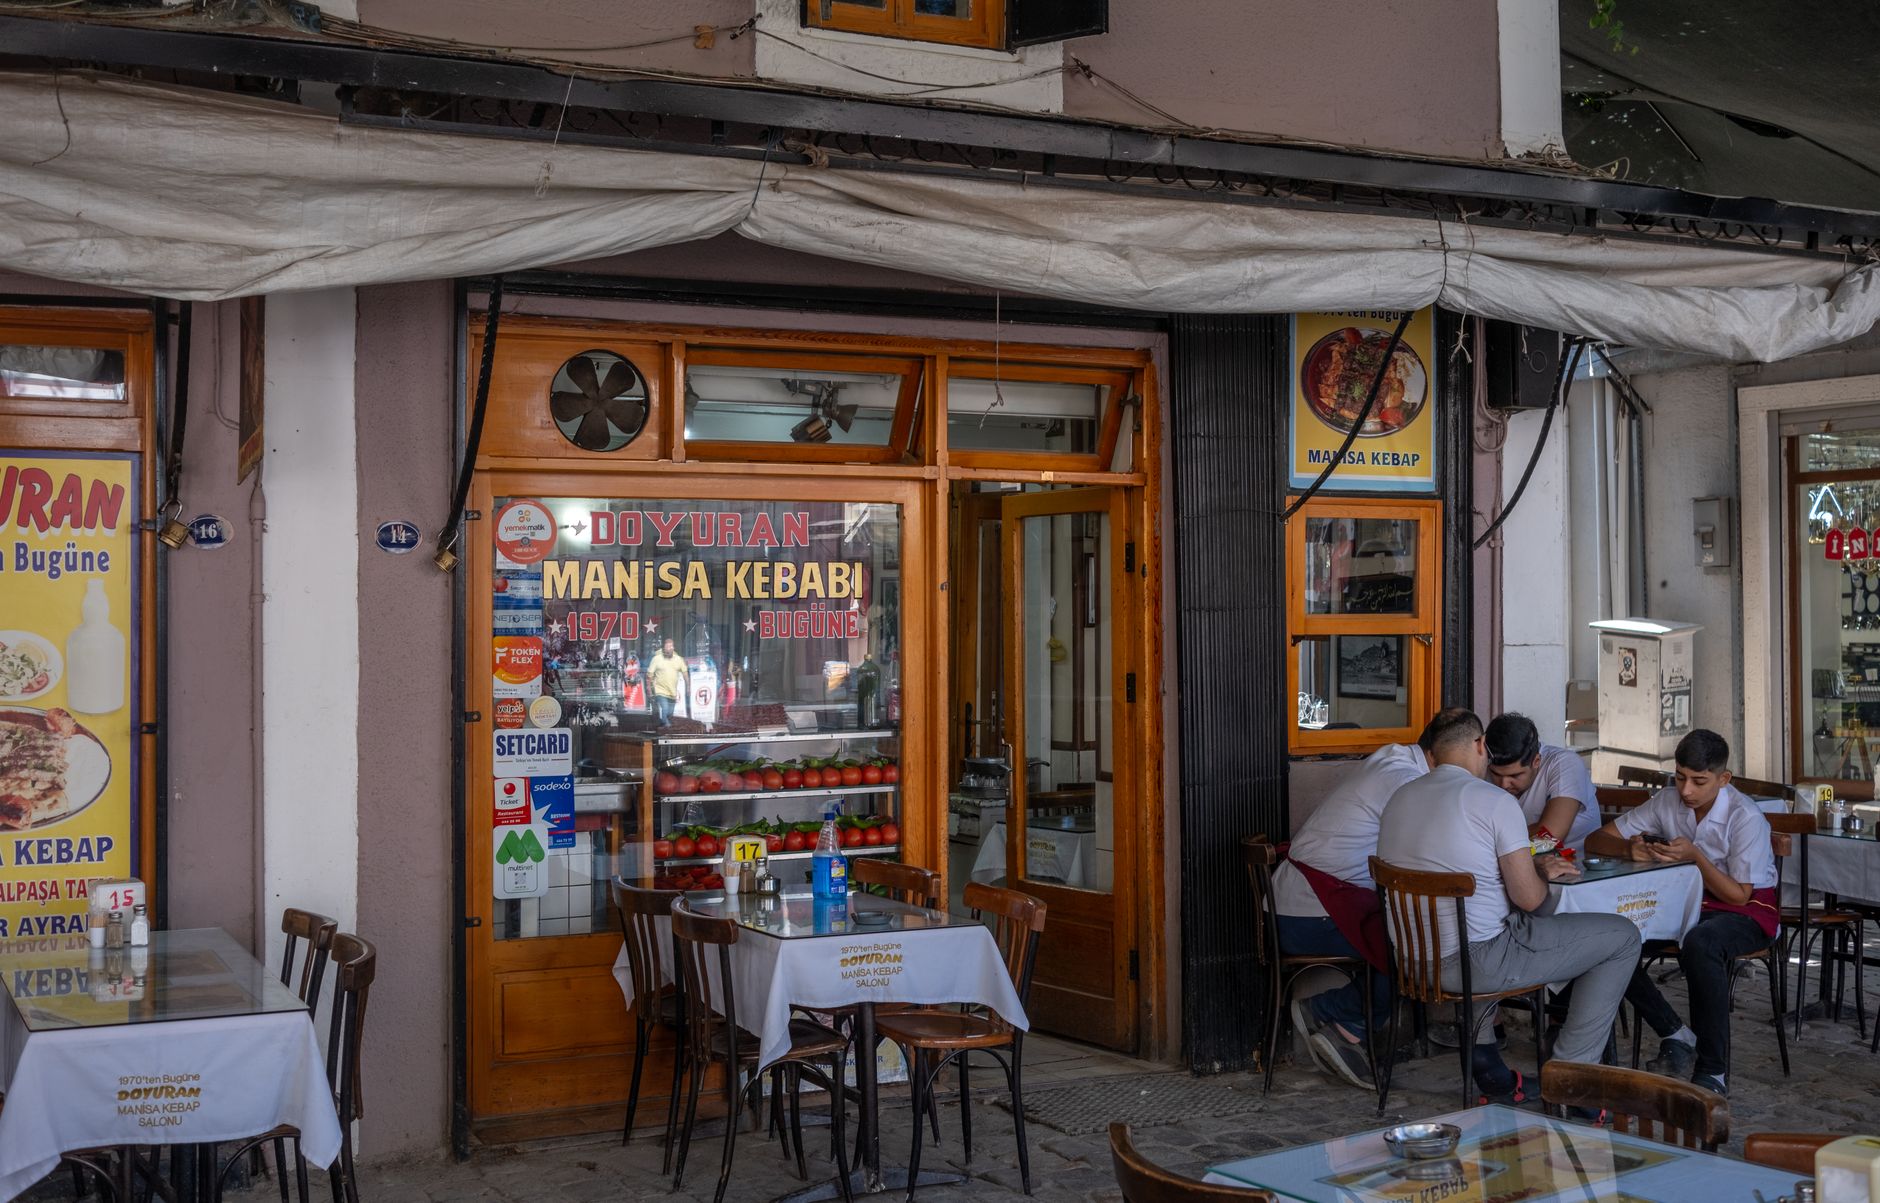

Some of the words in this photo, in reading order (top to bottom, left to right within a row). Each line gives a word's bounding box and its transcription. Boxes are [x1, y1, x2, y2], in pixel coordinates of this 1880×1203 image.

[1371, 451, 1420, 466] KEBAP
[200, 523, 217, 538] 16
[591, 511, 810, 547] DOYURAN
[15, 542, 110, 580] Bugüne
[725, 560, 865, 600] KEBABI
[566, 611, 640, 641] 1970
[759, 603, 860, 639] BUGÜNE
[510, 648, 541, 656] TOKEN
[511, 656, 533, 664] FLEX
[496, 733, 569, 756] SETCARD
[533, 781, 571, 792] sodexo
[1822, 788, 1832, 801] 19
[14, 836, 114, 866] KEBAP
[738, 843, 760, 860] 17
[507, 864, 534, 872] multinet
[109, 889, 134, 911] 15
[17, 914, 89, 938] AYRA
[873, 943, 902, 952] Bugüne
[840, 953, 903, 967] DOYURAN
[873, 966, 903, 976] KEBAP
[856, 978, 890, 988] SALONU
[118, 1075, 162, 1086] 1970'ten
[162, 1073, 201, 1084] Bugüne
[117, 1085, 202, 1101] DOYURAN
[117, 1102, 160, 1116] MANİSA
[162, 1101, 201, 1113] KEBAP
[138, 1115, 183, 1127] SALONU
